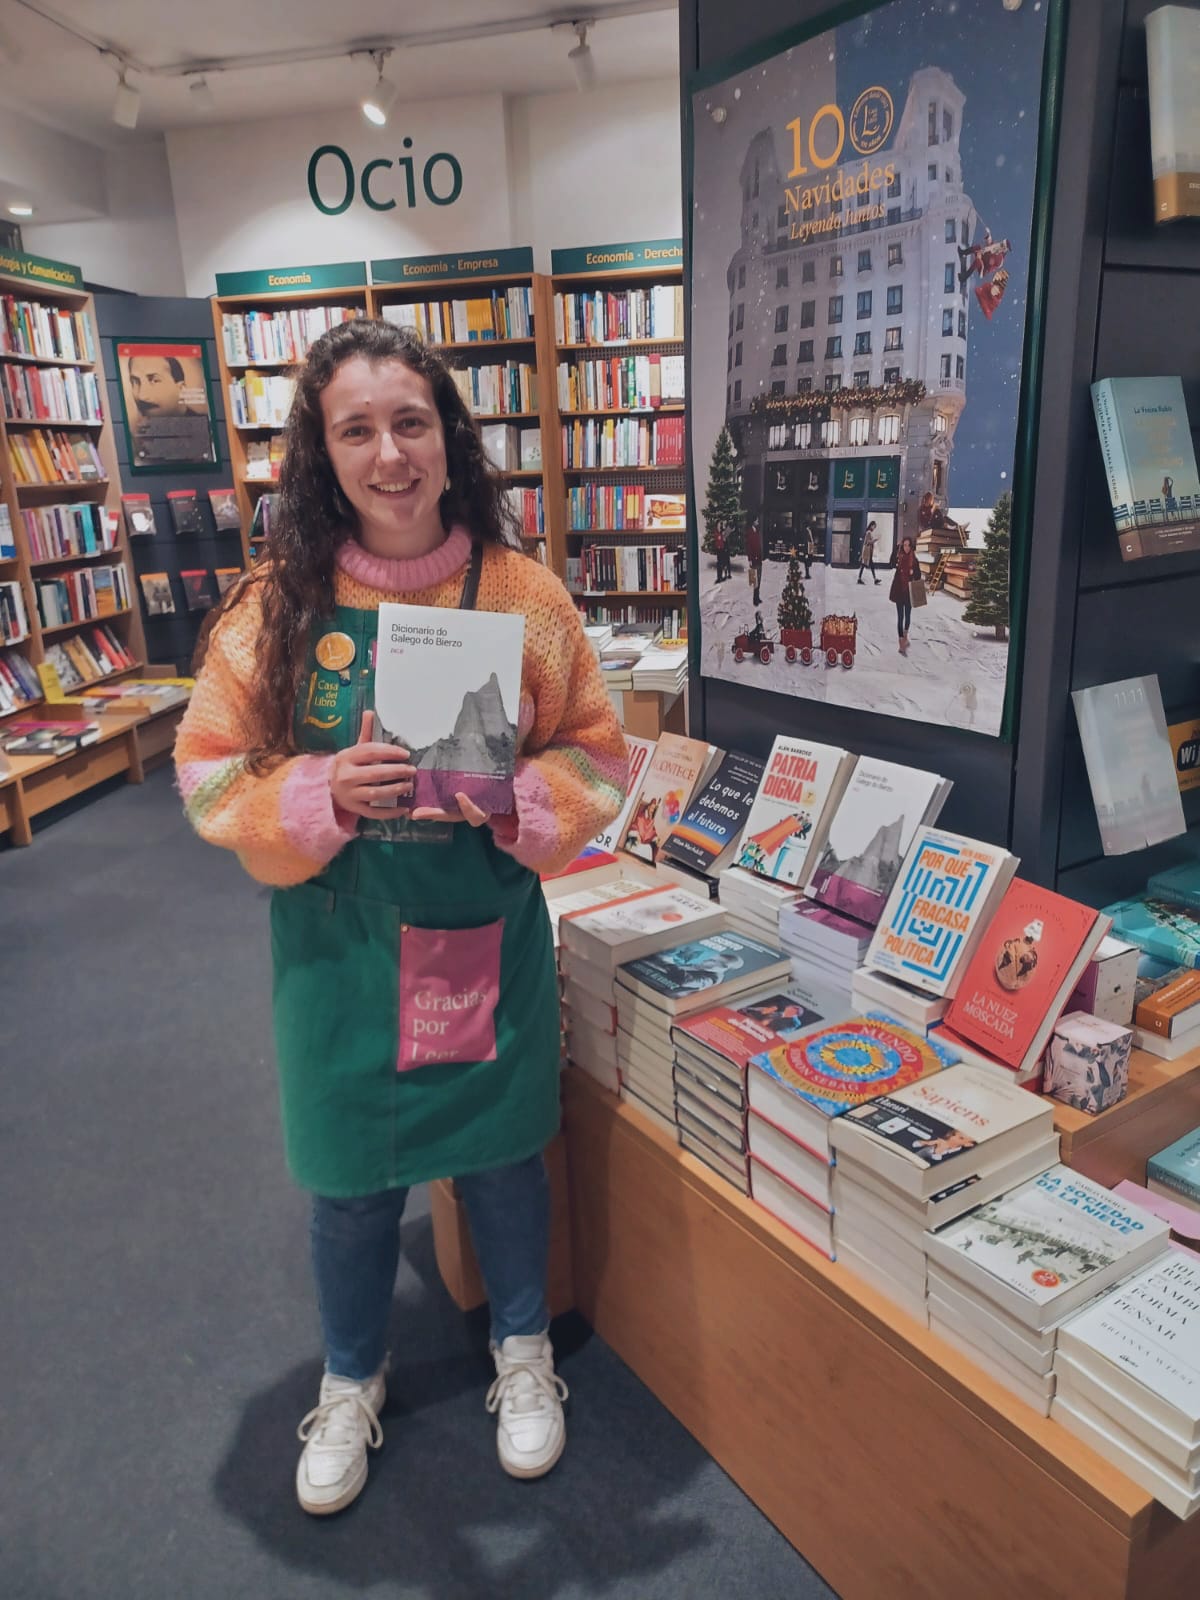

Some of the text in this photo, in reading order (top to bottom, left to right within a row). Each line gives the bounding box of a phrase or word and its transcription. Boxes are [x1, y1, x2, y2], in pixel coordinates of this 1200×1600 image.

[785, 103, 845, 179] 10
[307, 136, 463, 216] Ocio
[784, 162, 895, 215] Navidades
[790, 203, 885, 242] Leyendo Juntos
[403, 260, 448, 276] Economía
[456, 256, 499, 272] Empresa
[586, 249, 634, 265] Economía
[20, 261, 27, 275] y
[28, 261, 77, 284] Comunicación
[268, 273, 312, 287] Economía
[391, 623, 448, 637] Dicionario do
[391, 633, 463, 648] Galego do Bierzo
[317, 679, 339, 691] Casa
[325, 690, 338, 700] del
[314, 697, 336, 708] Libro
[770, 752, 818, 783] PATRIA
[709, 778, 720, 791] Lo
[721, 785, 741, 800] que
[742, 791, 754, 807] le
[762, 776, 804, 804] DIGNA
[698, 794, 740, 821] debemos
[687, 810, 727, 836] al futuro
[919, 850, 973, 878] POR QUÉ
[912, 898, 971, 932] FRACASA
[884, 935, 935, 967] POLÍTICA
[414, 987, 487, 1012] Gracias
[972, 991, 988, 1006] LA
[987, 999, 1019, 1024] NUEZ
[413, 1018, 450, 1038] por
[963, 1002, 1015, 1040] MOSCADA
[860, 1025, 918, 1063] MUNDO
[812, 1073, 860, 1093] SEBAG
[912, 1086, 990, 1127] Sapiens
[1035, 1179, 1134, 1235] DE LA NIEVE
[1042, 1171, 1145, 1232] LA SOCIEDAD
[1113, 1298, 1176, 1340] PENSAR
[1131, 1287, 1188, 1325] FORMA
